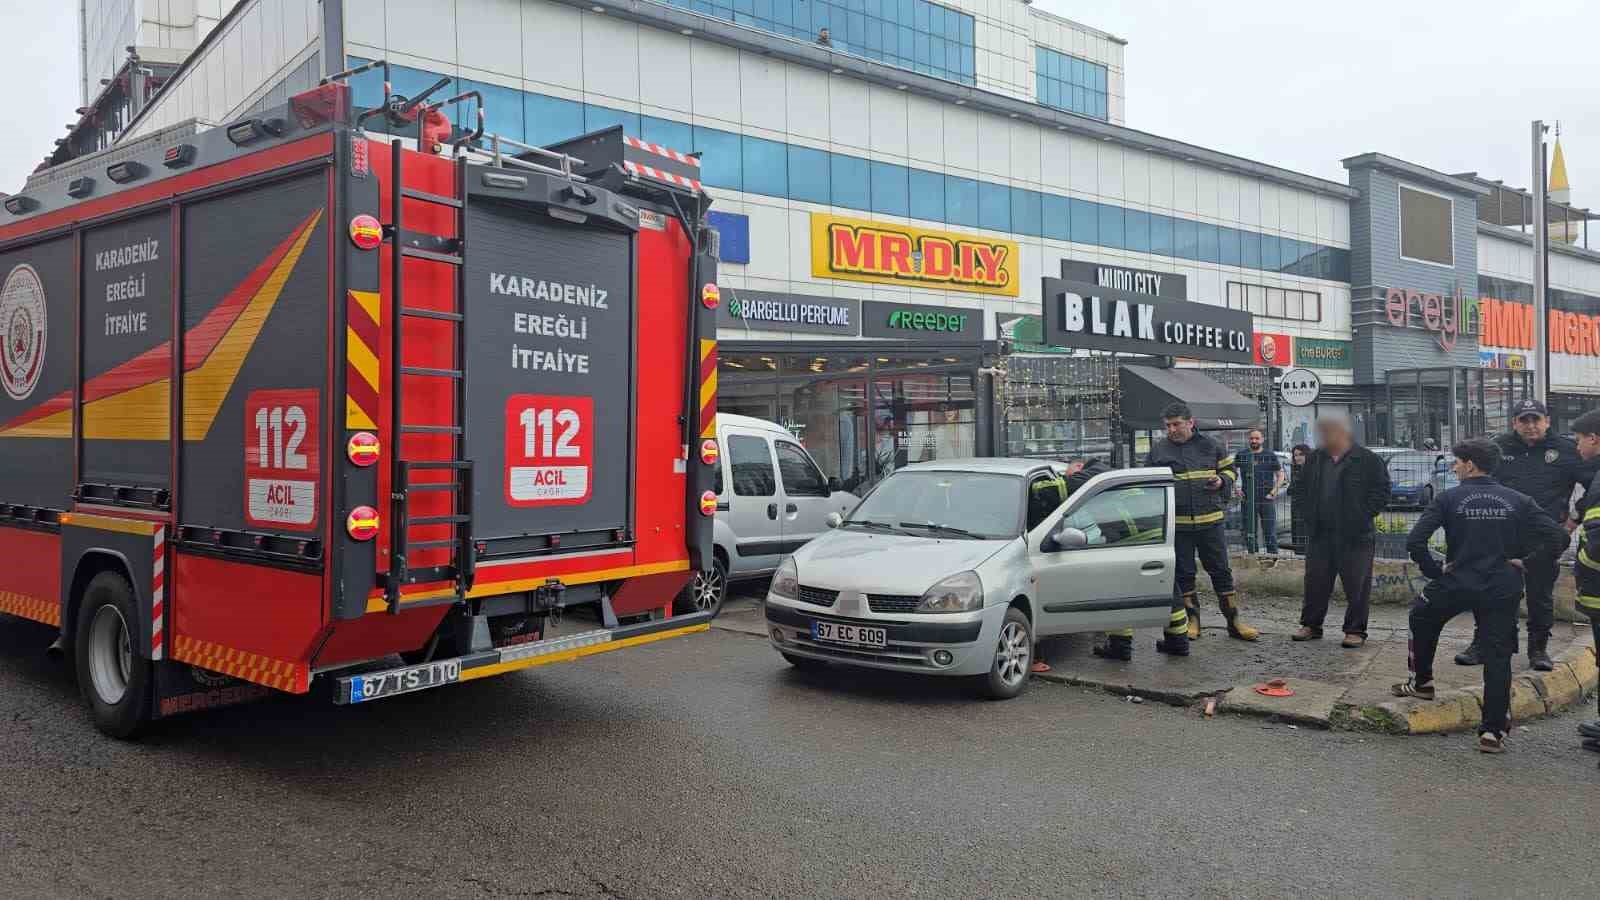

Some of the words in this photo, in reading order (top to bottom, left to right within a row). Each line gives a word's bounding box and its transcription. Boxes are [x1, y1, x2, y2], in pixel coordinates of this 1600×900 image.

[95, 237, 159, 271] KARADENİZ
[106, 272, 146, 302] EREĞLİ
[490, 272, 609, 310] KARADENİZ
[1134, 272, 1161, 297] CITY
[105, 309, 147, 336] İTFAİYE
[514, 312, 587, 340] EREĞLİ
[741, 299, 798, 322] BARGELLO
[800, 304, 849, 326] PERFUME
[1064, 291, 1156, 341] BLAK
[1164, 321, 1223, 348] COFFEE
[1229, 330, 1250, 352] CO.
[512, 343, 590, 374] İTFAİYE
[1283, 381, 1317, 390] BLAK
[255, 405, 308, 470] 112
[519, 407, 581, 458] 112
[816, 623, 832, 638] 67
[837, 626, 854, 641] EC
[859, 628, 884, 644] 609
[363, 675, 387, 697] 67
